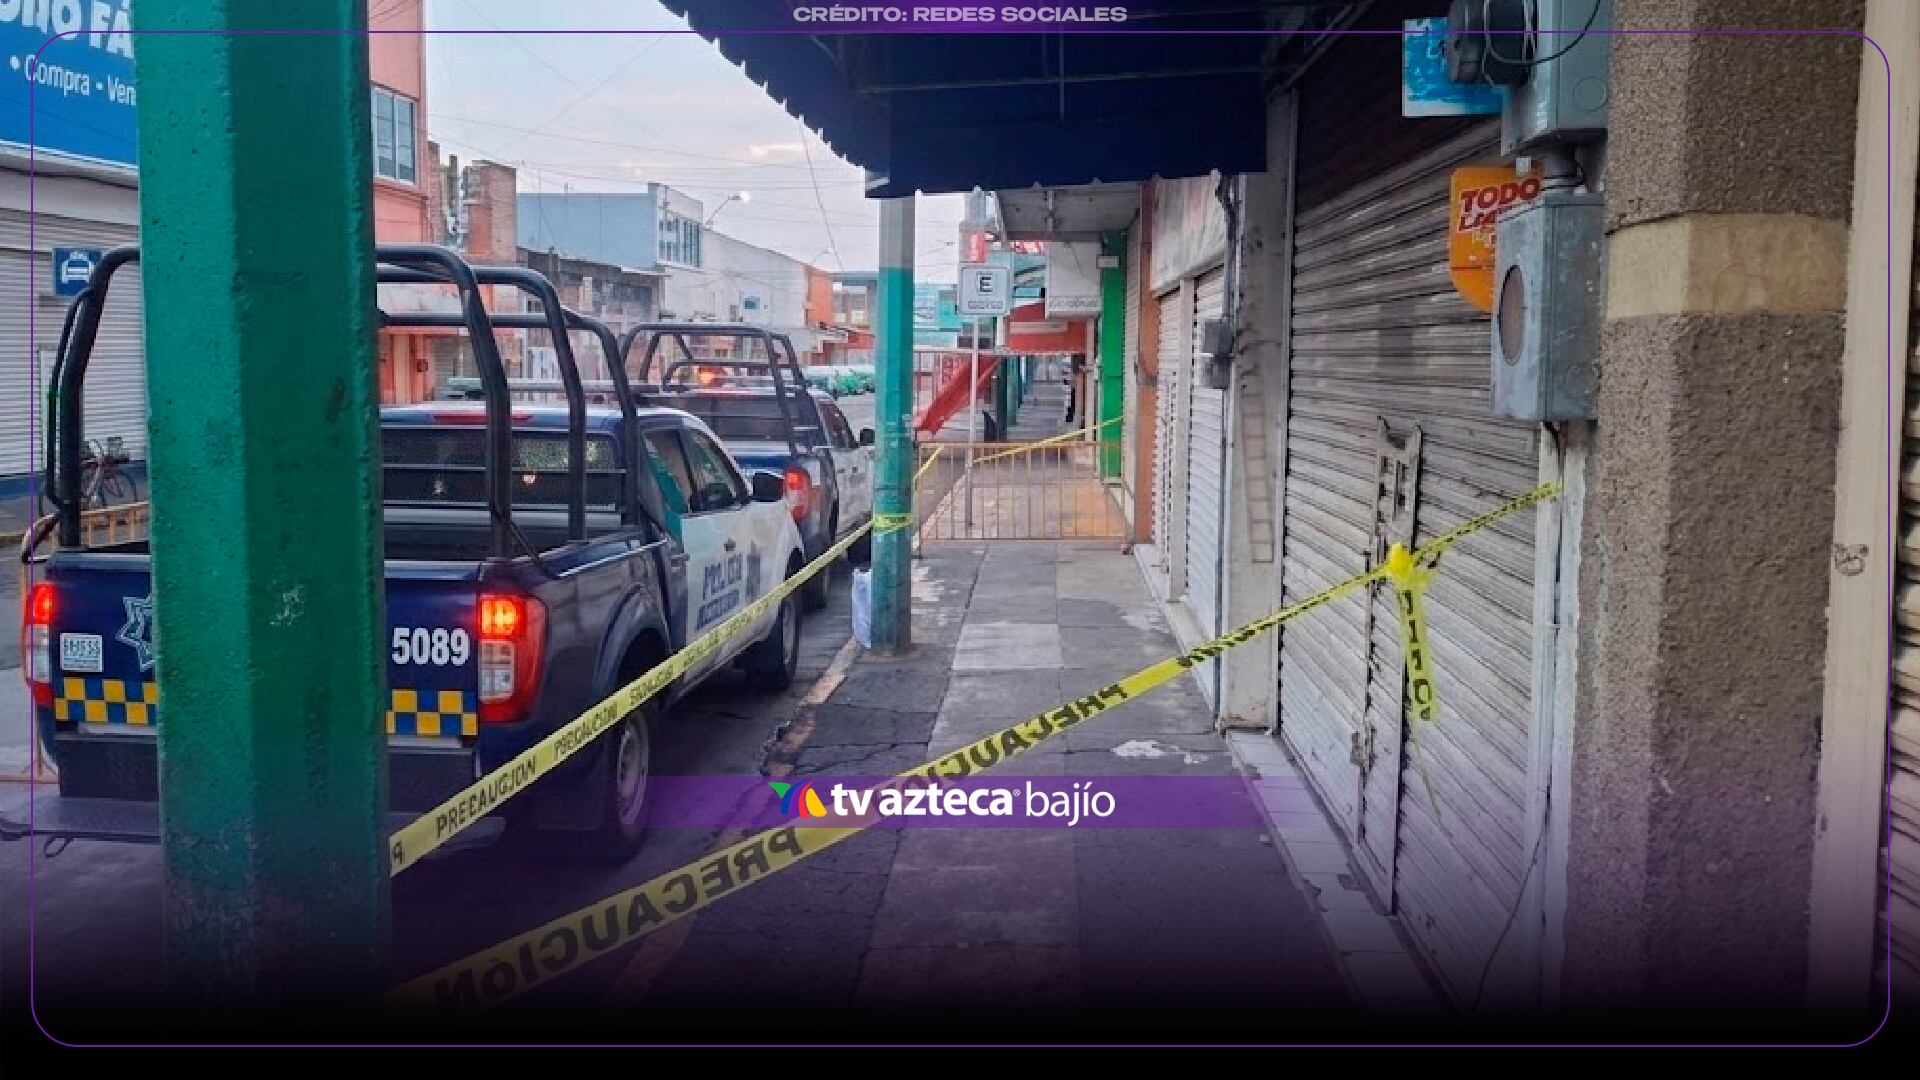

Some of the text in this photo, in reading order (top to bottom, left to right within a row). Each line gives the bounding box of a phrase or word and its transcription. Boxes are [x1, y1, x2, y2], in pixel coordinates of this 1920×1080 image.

[25, 54, 90, 97] Compra
[1460, 178, 1540, 213] TODO
[979, 276, 992, 293] E
[392, 627, 470, 666] 5089
